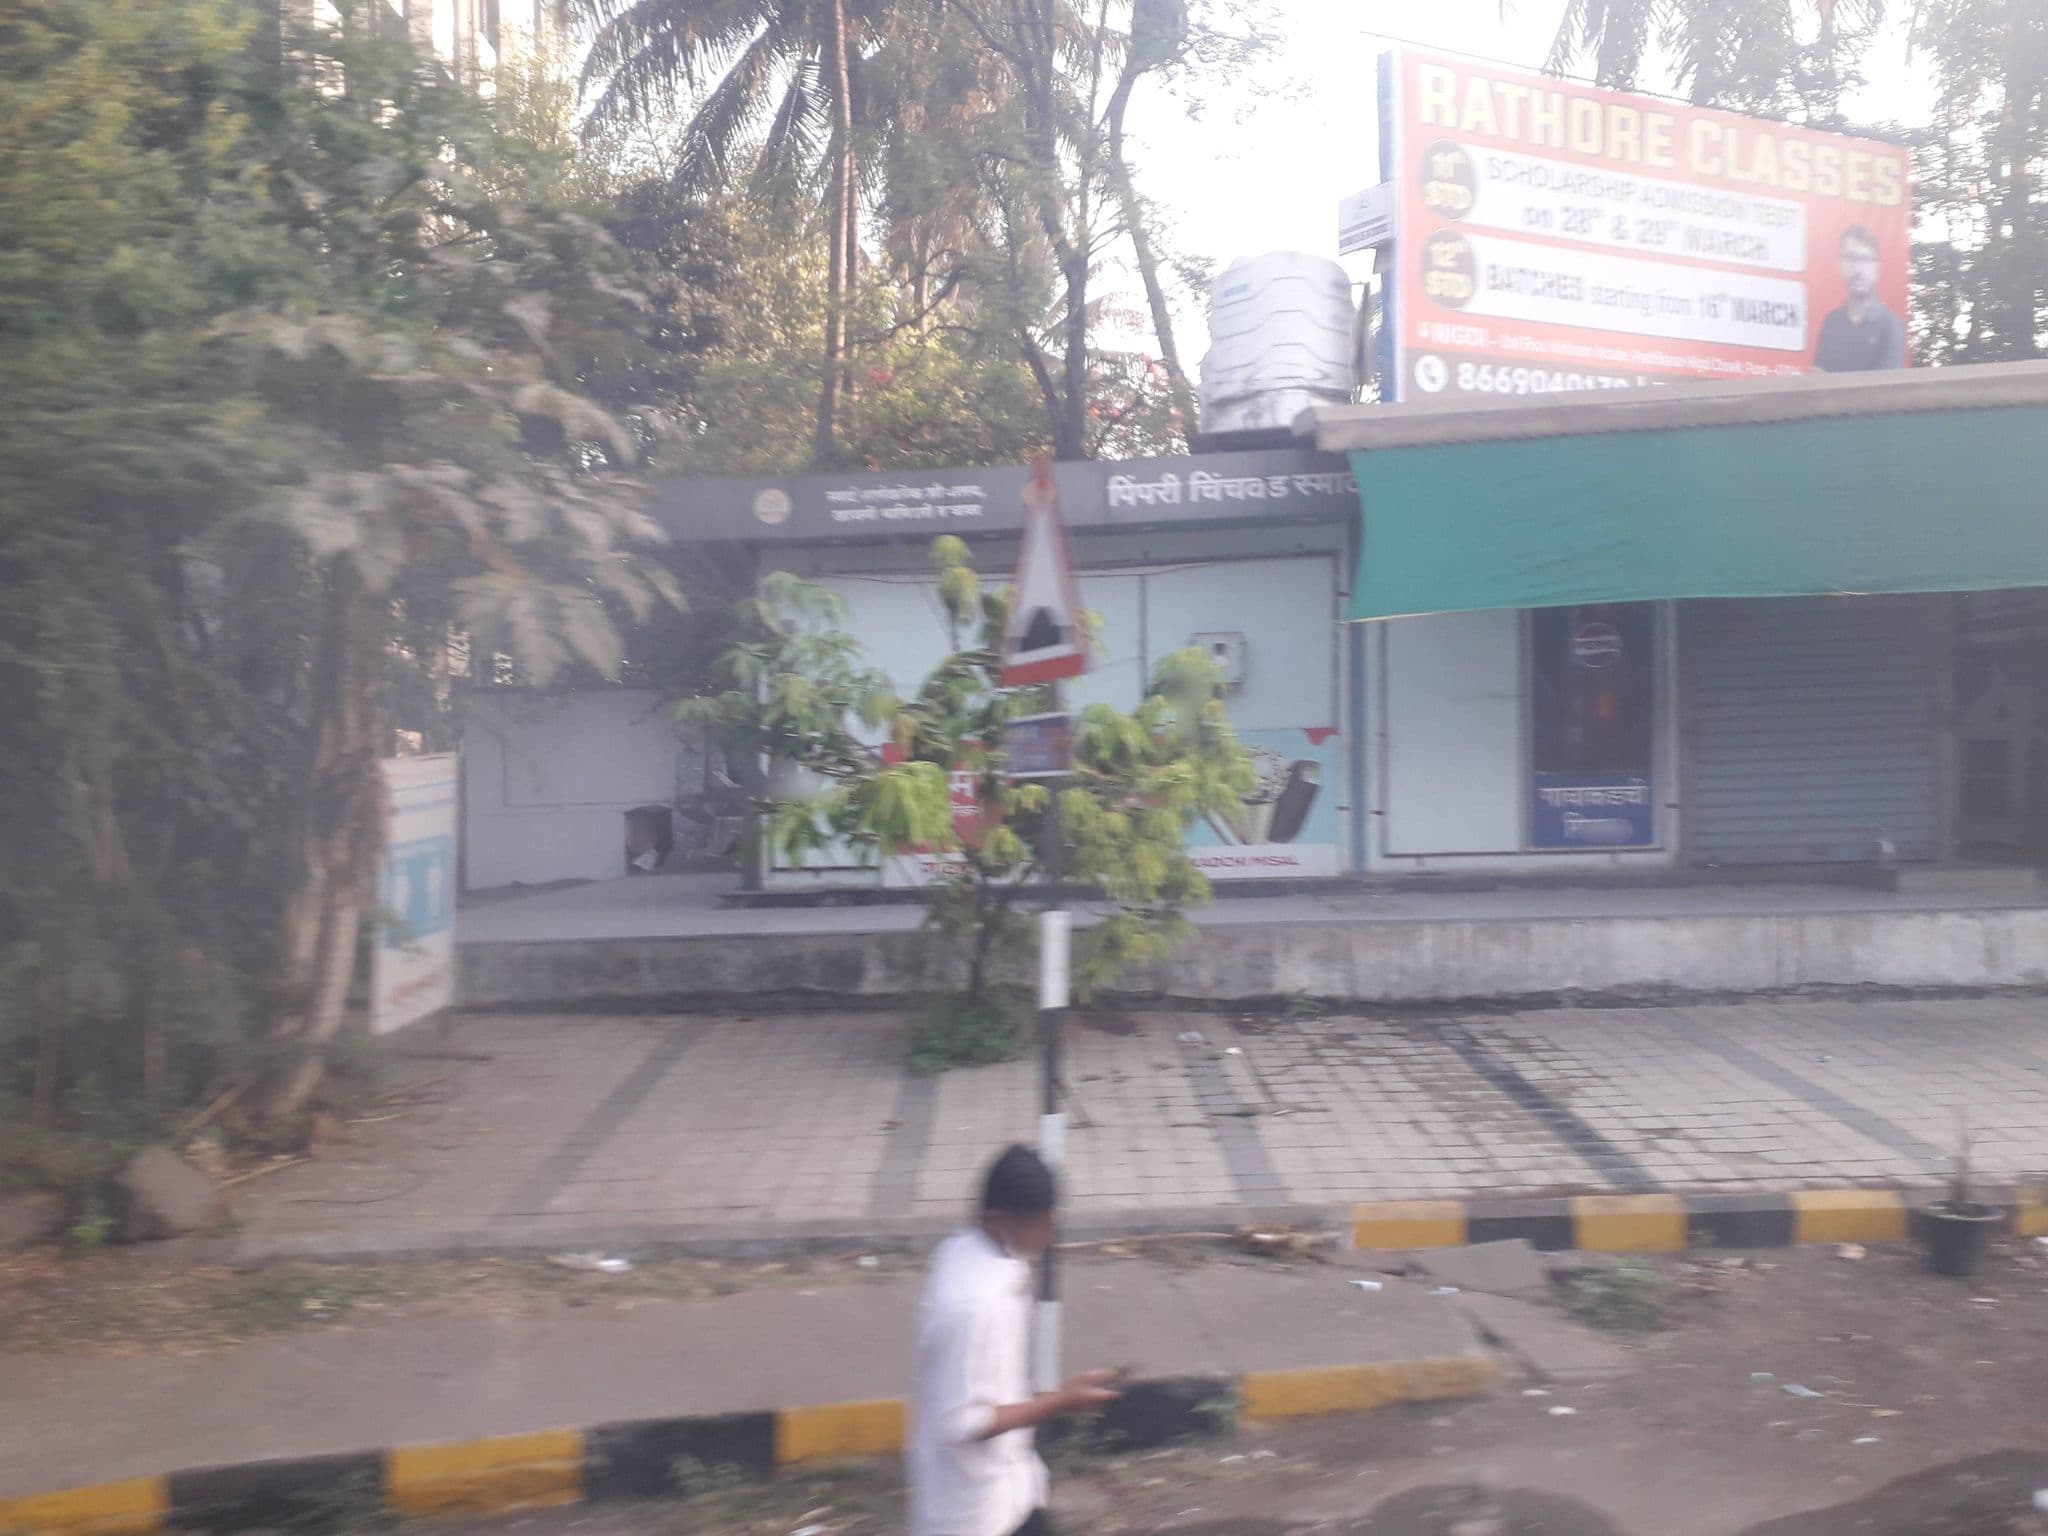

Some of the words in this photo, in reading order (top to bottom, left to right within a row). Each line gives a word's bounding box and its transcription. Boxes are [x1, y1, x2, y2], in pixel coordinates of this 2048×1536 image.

[1418, 63, 1675, 167] RATHORE
[1690, 119, 1900, 205] CLASSES
[1487, 156, 1637, 203] SCHOLARSHIP
[1610, 213, 1631, 241] &
[1682, 224, 1769, 260] MARCH
[1486, 262, 1585, 301] BATCHES
[1590, 281, 1651, 318] starting
[1655, 287, 1695, 316] from
[1730, 295, 1800, 328] MARCH
